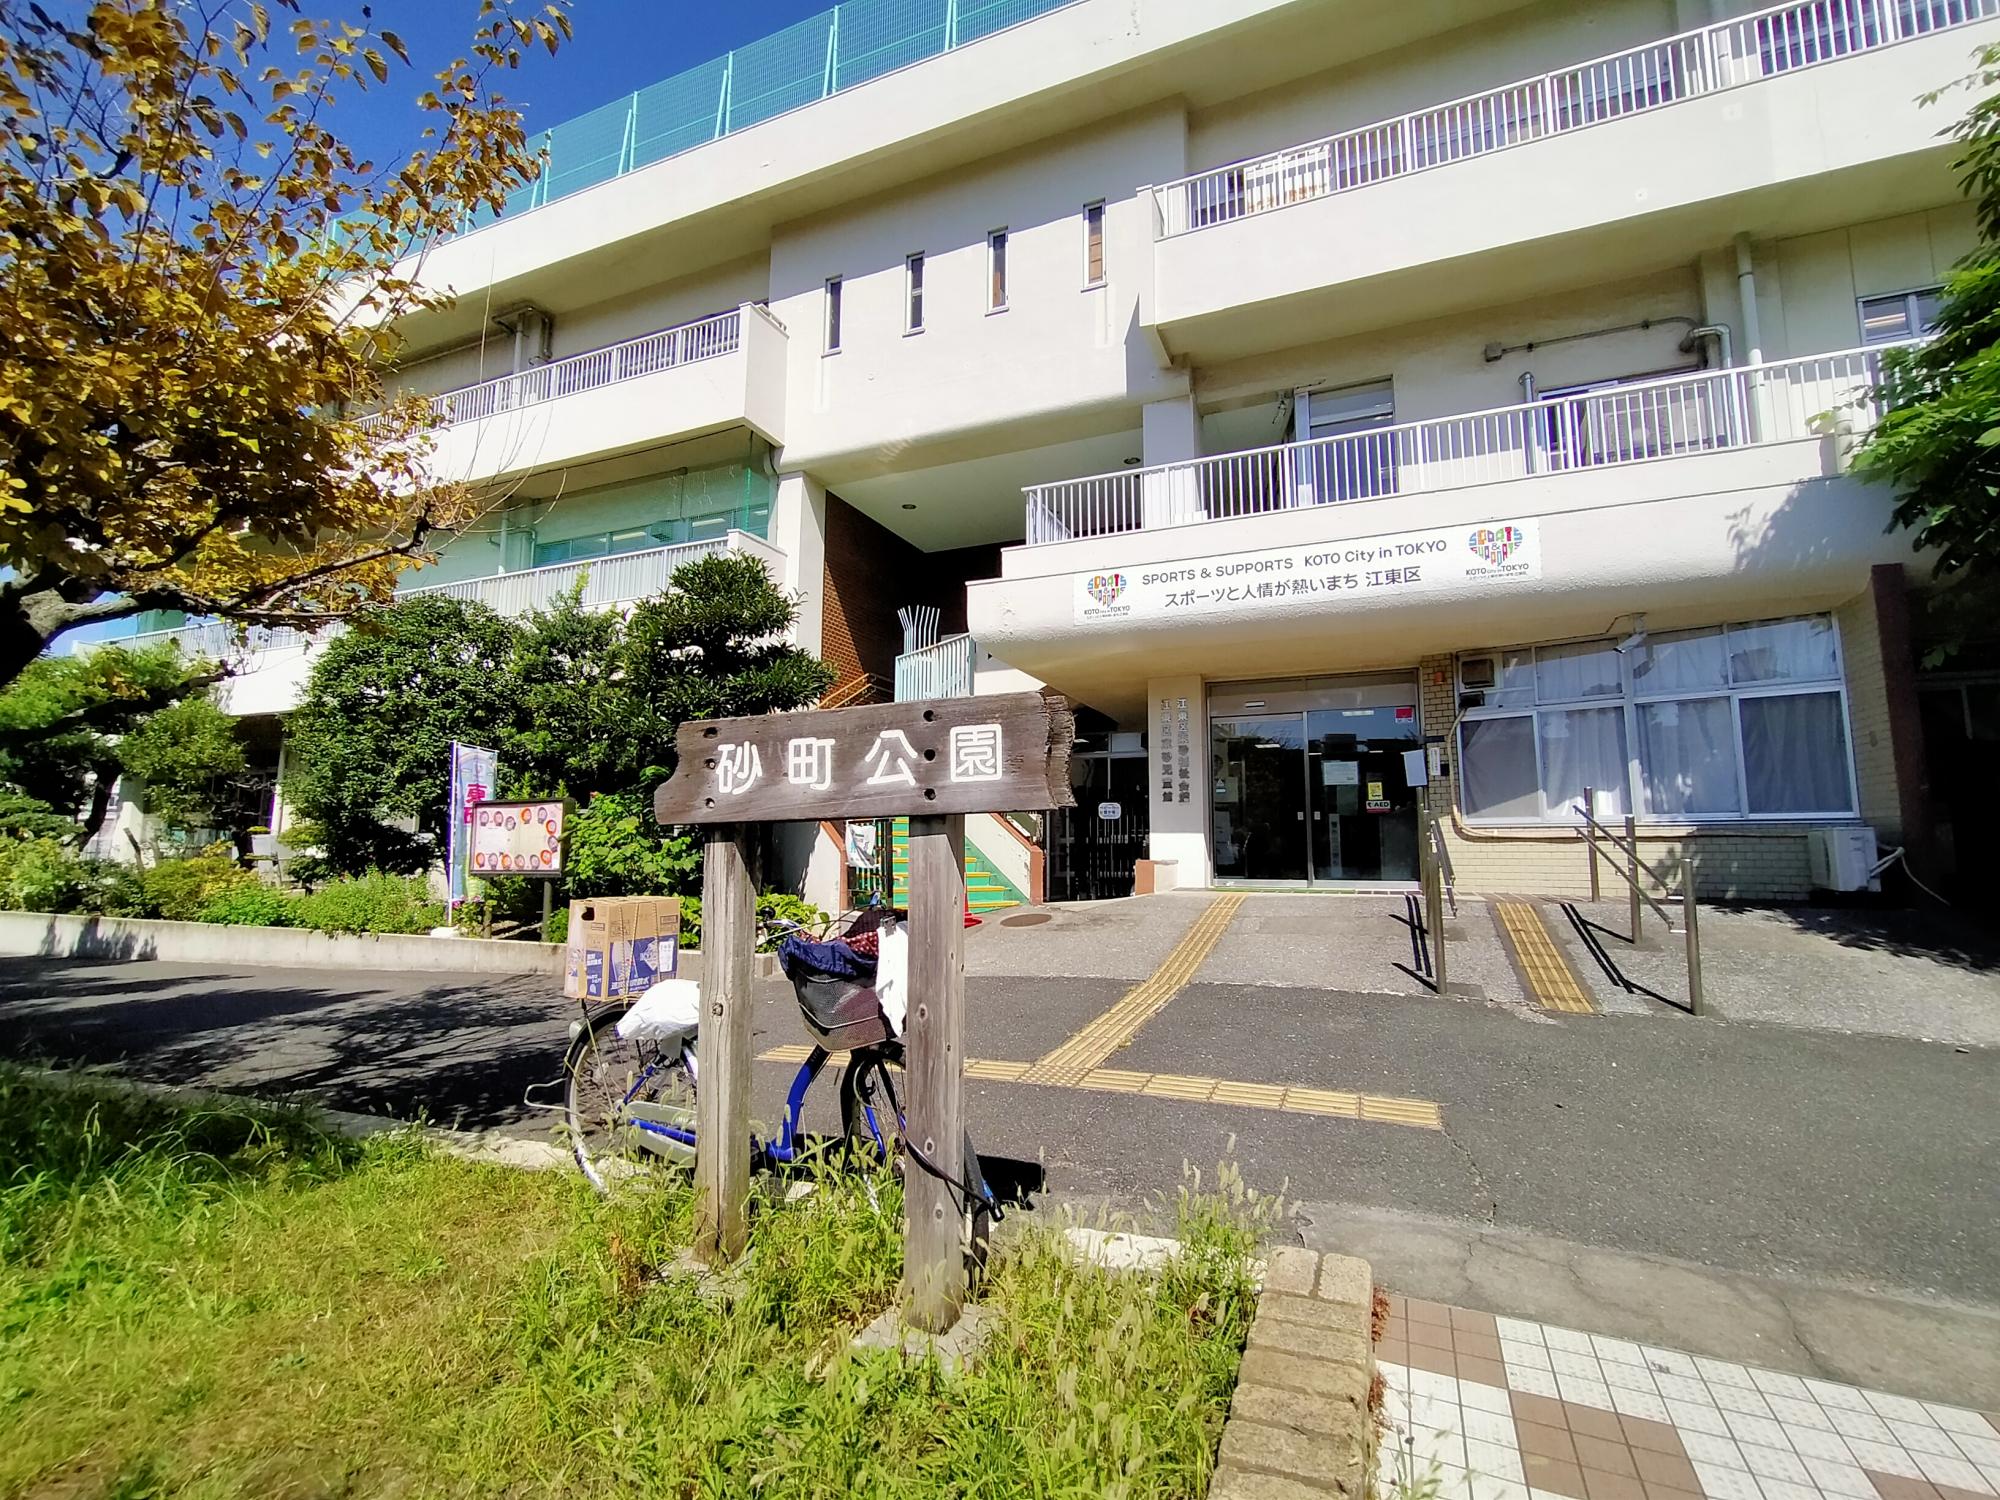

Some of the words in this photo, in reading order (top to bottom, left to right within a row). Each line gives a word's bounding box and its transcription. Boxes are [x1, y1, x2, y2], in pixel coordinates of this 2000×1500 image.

[1142, 569, 1196, 585] SPORTS
[1200, 567, 1212, 579] &
[1215, 558, 1294, 577] SUPPORTS
[1304, 552, 1341, 567] KOTO
[1345, 550, 1375, 562] City
[1379, 547, 1393, 559] in
[1395, 540, 1447, 557] TOKYO
[1465, 567, 1487, 576] KOTO
[1502, 563, 1529, 572] TOKYO
[1164, 573, 1359, 608] スポーツと人情が熱いまち
[1365, 565, 1422, 587] 江東区
[1110, 605, 1131, 613] TOKYO
[715, 723, 1003, 796] 砂町公園
